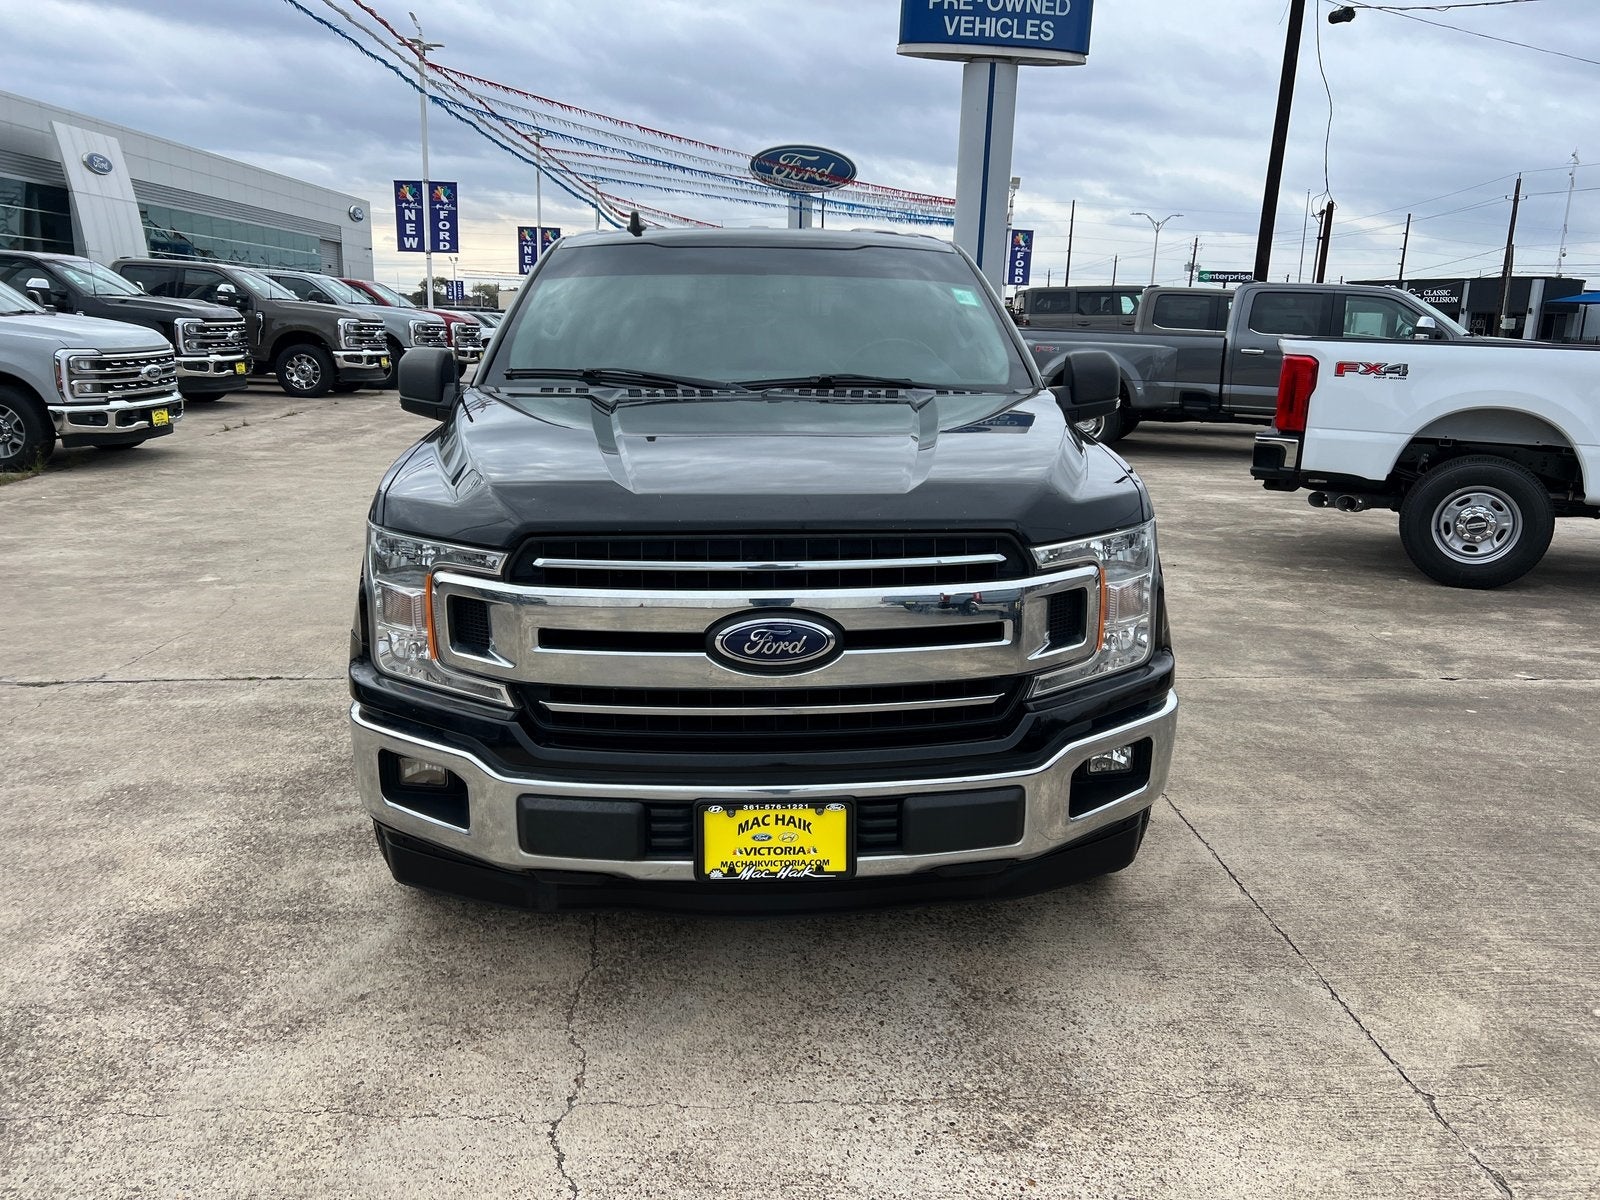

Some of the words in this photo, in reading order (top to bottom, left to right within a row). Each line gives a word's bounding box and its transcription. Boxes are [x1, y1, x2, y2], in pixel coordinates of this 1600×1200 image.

[944, 16, 1054, 41] VEHICLES
[772, 153, 835, 181] Ford
[403, 209, 418, 249] NEW
[438, 210, 451, 251] FORD
[523, 245, 534, 273] NEW
[1014, 251, 1025, 283] FORD
[1200, 272, 1252, 281] enterprise
[1334, 361, 1409, 377] FX4
[743, 628, 808, 655] Ford
[737, 814, 771, 836] MAC
[774, 814, 813, 835] HAIK
[720, 859, 830, 868] MACHAIKVICTORIA.COM
[743, 846, 806, 856] VICTORIA
[738, 866, 776, 880] Mac
[776, 864, 817, 880] Haik
